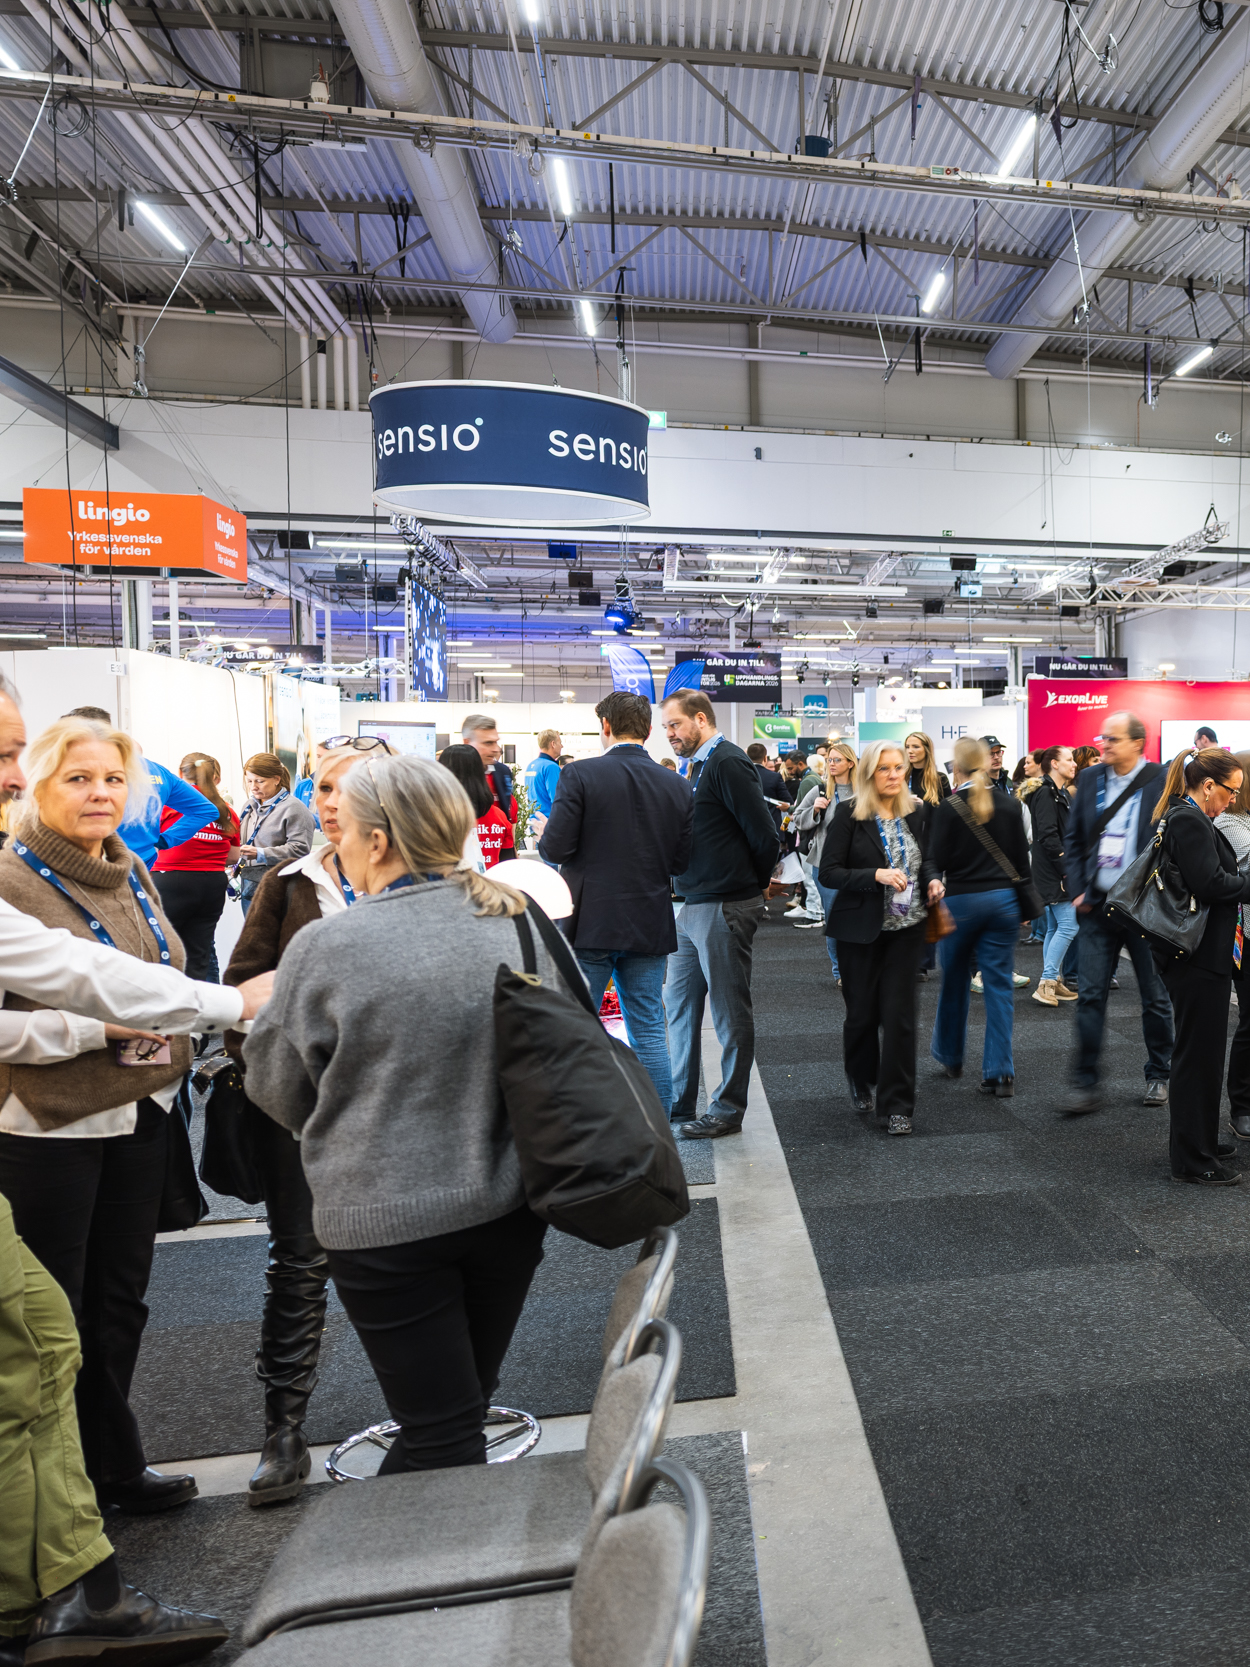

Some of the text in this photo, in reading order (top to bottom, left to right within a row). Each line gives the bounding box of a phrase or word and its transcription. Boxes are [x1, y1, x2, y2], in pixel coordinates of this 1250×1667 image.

[377, 423, 480, 459] sensio
[78, 501, 150, 526] lingio
[216, 512, 236, 539] lingio
[67, 531, 162, 544] Yrkessvenska
[79, 543, 151, 556] för vården
[214, 541, 239, 559] Yrkessvenska
[224, 555, 236, 569] vården
[272, 652, 283, 660] IN
[706, 658, 724, 667] GÅR
[725, 659, 737, 667] DU
[738, 659, 748, 667] IN
[1062, 662, 1077, 670] GÅR
[490, 823, 506, 835] för
